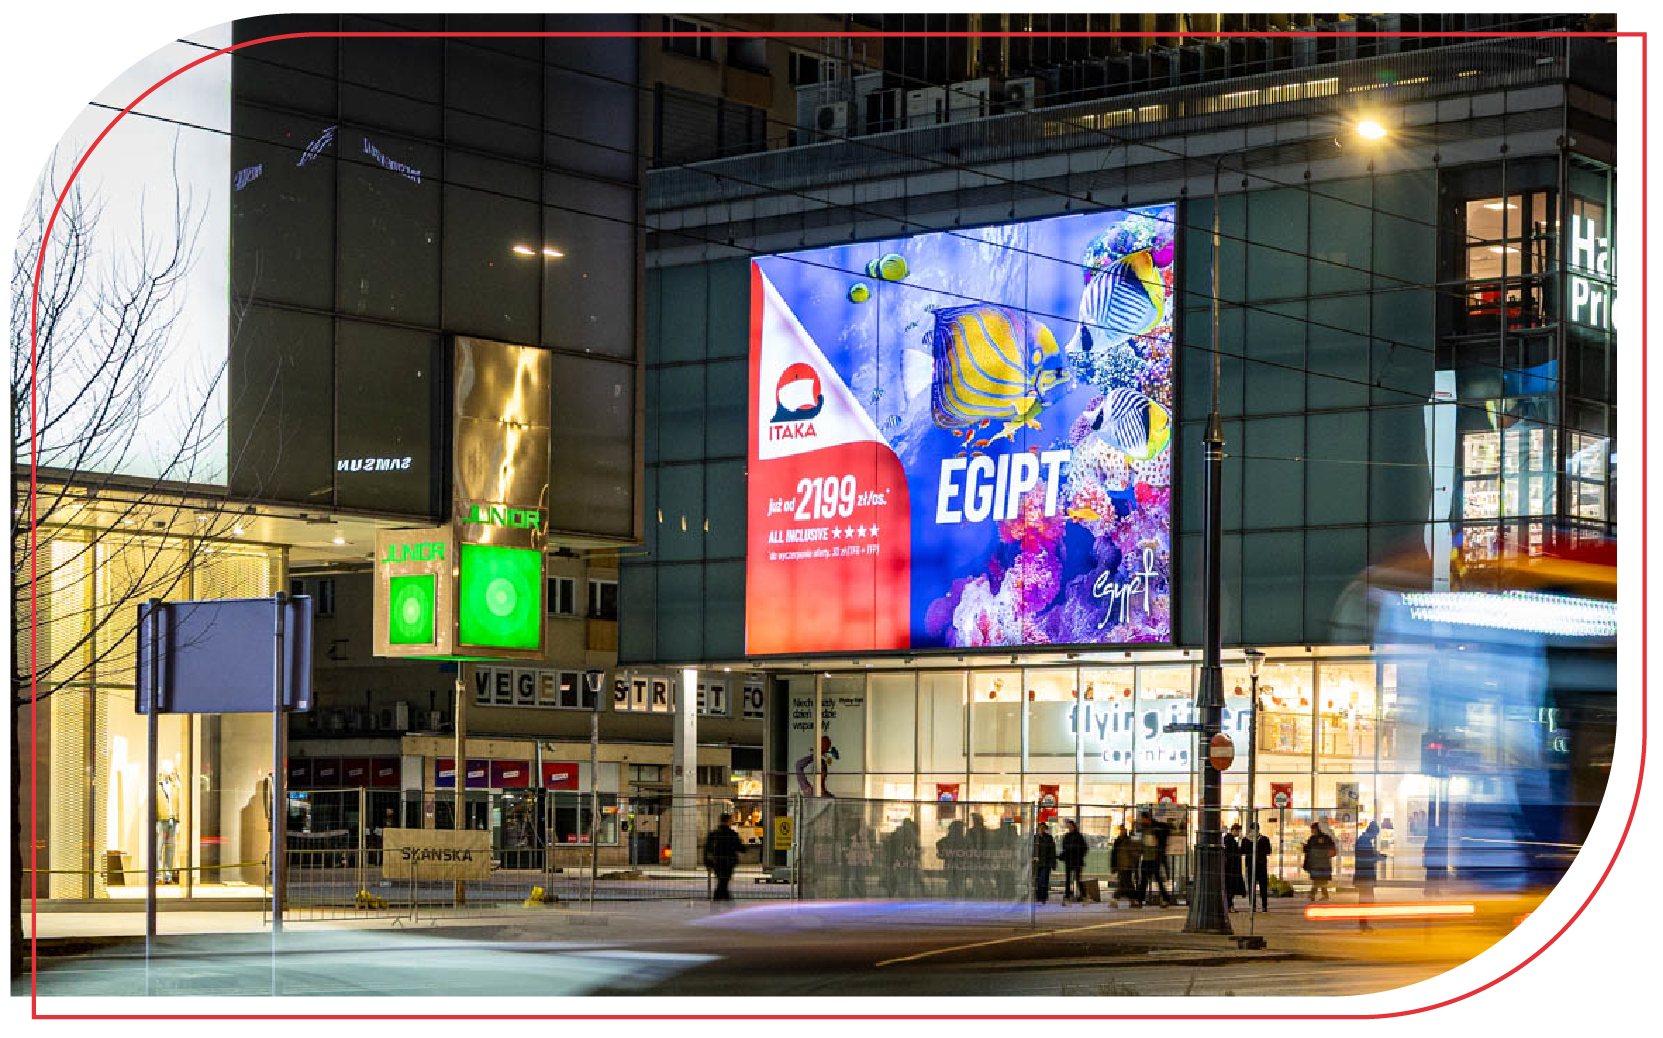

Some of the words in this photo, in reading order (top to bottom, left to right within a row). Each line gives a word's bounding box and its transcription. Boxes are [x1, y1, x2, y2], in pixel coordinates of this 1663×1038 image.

[1572, 276, 1616, 329] Pri
[769, 422, 817, 440] ITAKA
[784, 497, 796, 512] od
[793, 474, 856, 521] 2199
[936, 449, 1070, 524] EGIPT
[462, 504, 540, 529] JUNIOR
[768, 529, 784, 544] ALL
[786, 527, 829, 543] INCLUSIVE
[382, 542, 445, 563] JUNIOR
[614, 679, 724, 708] STRET
[402, 846, 473, 861] SKANSKA
